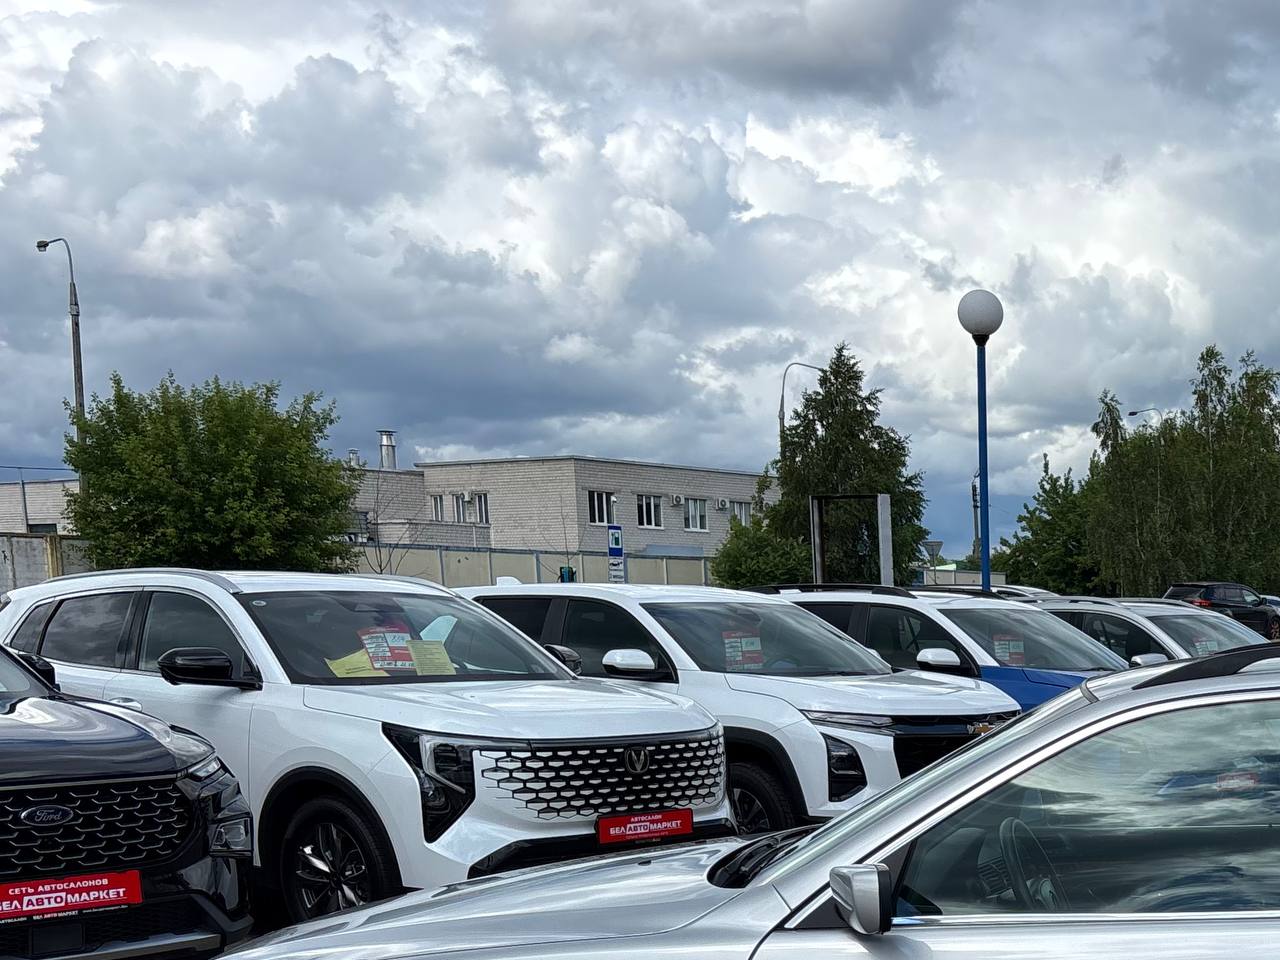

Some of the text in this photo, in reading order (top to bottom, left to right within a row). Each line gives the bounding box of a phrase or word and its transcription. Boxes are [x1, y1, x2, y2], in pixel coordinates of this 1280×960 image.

[35, 810, 62, 821] Ford
[630, 814, 662, 823] АВТОСАЛОН
[609, 827, 626, 835] БЕЛ
[627, 823, 649, 833] АВТО
[650, 820, 682, 830] МАРКЕТ
[8, 878, 109, 896] СЕТЬ АВТОСАЛОНОВ
[24, 895, 65, 908] АВТО
[66, 887, 127, 904] МАРКЕТ
